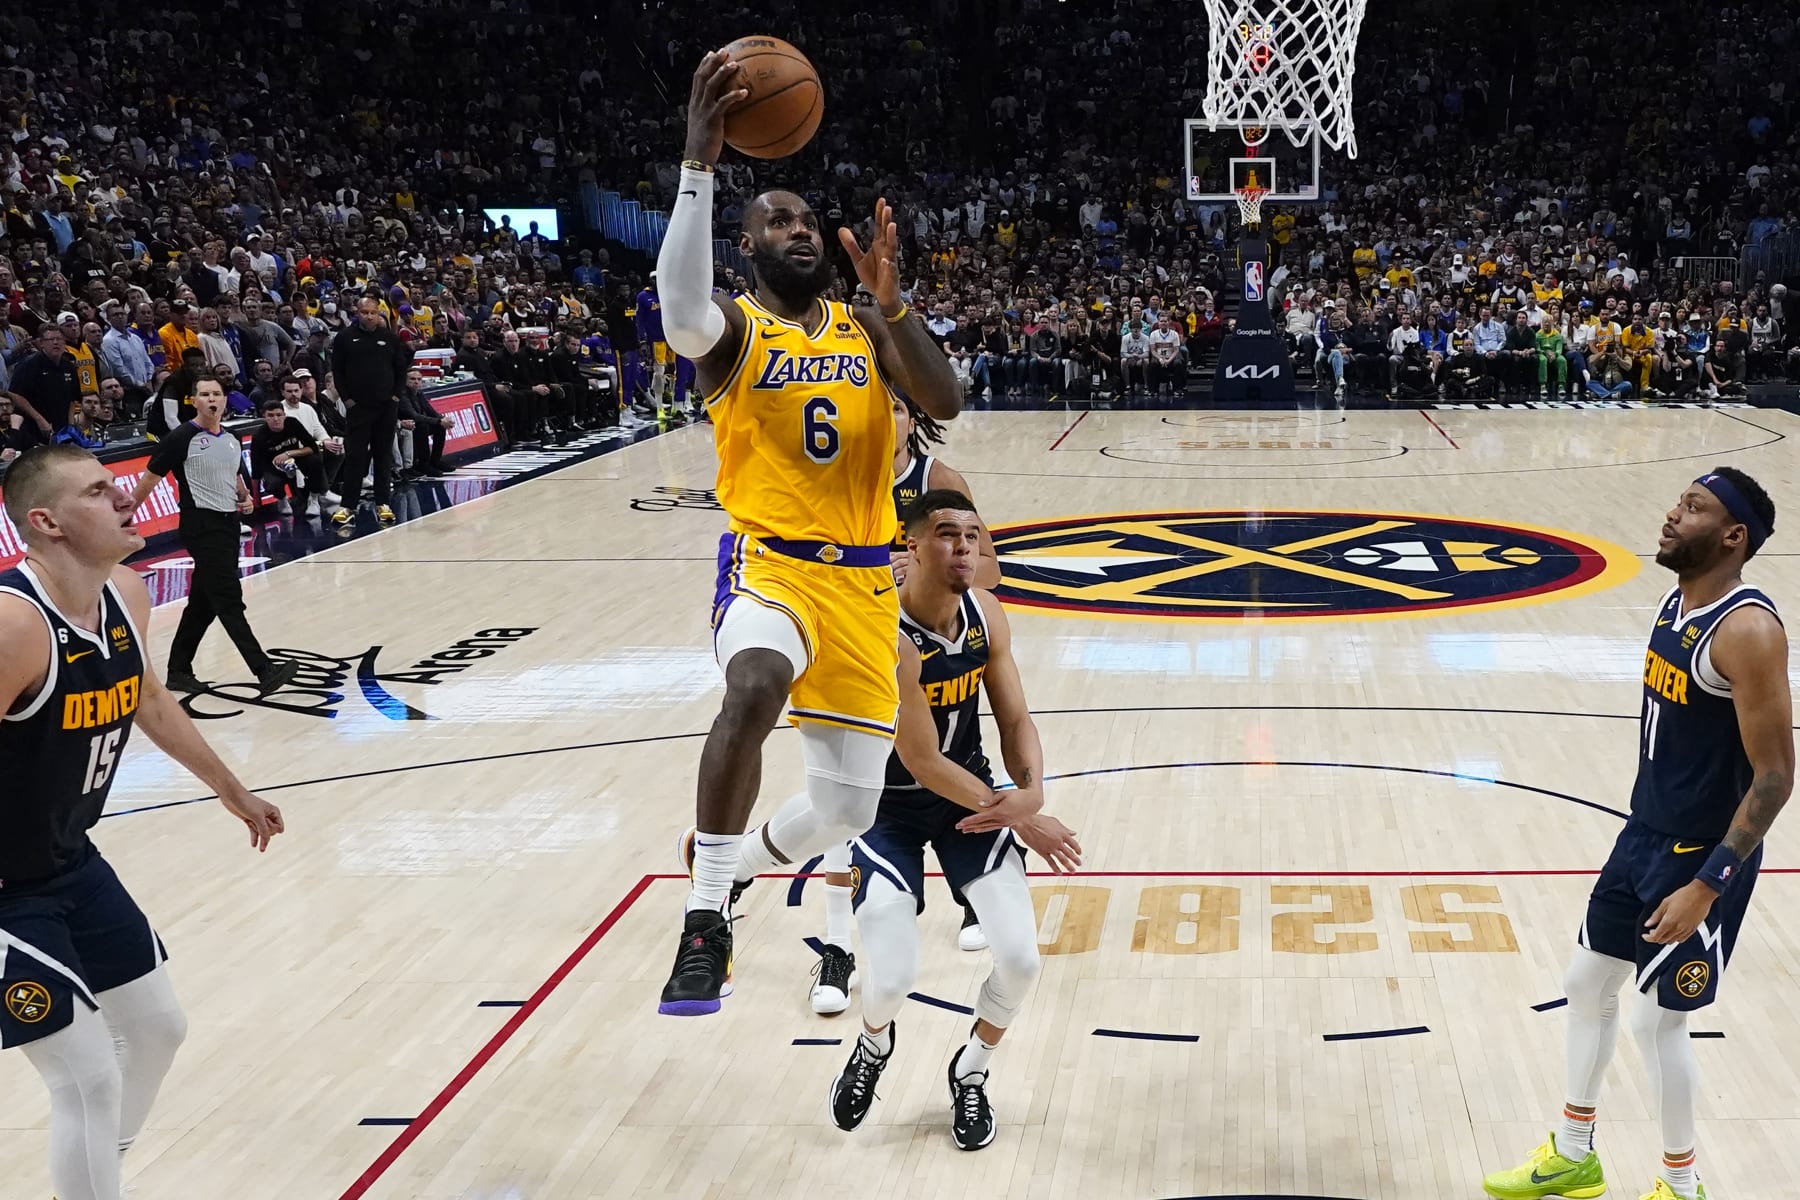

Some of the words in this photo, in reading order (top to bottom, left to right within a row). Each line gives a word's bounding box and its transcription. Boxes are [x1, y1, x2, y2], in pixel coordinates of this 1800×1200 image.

[834, 332, 861, 340] bibigo
[1236, 328, 1257, 337] Google
[1258, 328, 1271, 336] Pixel
[82, 370, 91, 385] 8
[752, 348, 869, 390] LAKERS
[803, 396, 840, 464] 6
[900, 489, 917, 498] WU
[57, 628, 70, 644] 6
[111, 624, 127, 641] WU
[912, 632, 923, 646] 6
[1685, 624, 1702, 640] WU
[374, 627, 539, 685] Arena
[921, 664, 986, 707] ENVE
[1644, 649, 1688, 705] ENVER
[941, 710, 960, 753] 1
[82, 727, 122, 795] 15
[1029, 884, 1521, 955] 5280
